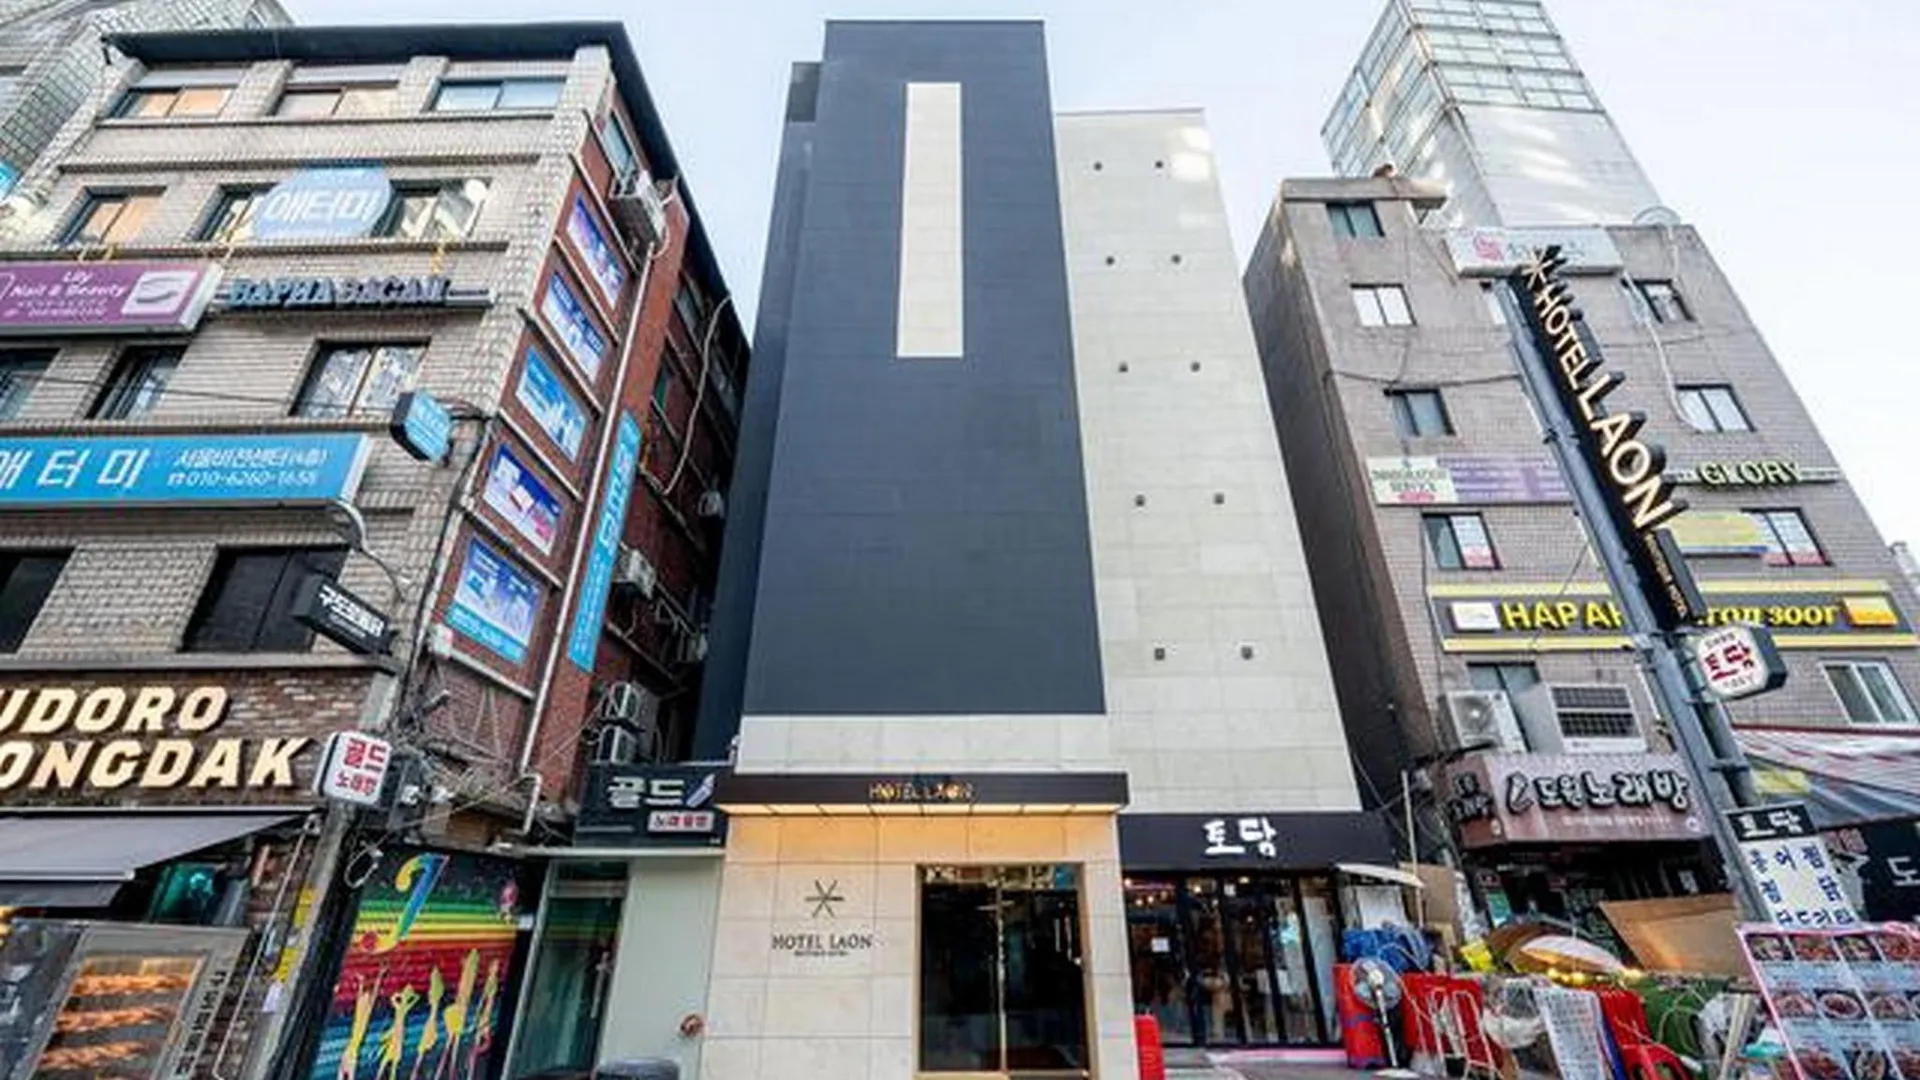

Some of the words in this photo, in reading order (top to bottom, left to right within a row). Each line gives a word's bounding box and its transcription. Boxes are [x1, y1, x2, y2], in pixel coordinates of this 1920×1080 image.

[1534, 285, 1595, 391] HOTEL
[1577, 370, 1674, 530] LAON
[1699, 459, 1801, 486] GLORY
[868, 781, 920, 801] HOTEL
[771, 934, 822, 950] HOTEL
[829, 933, 874, 950] LAON
